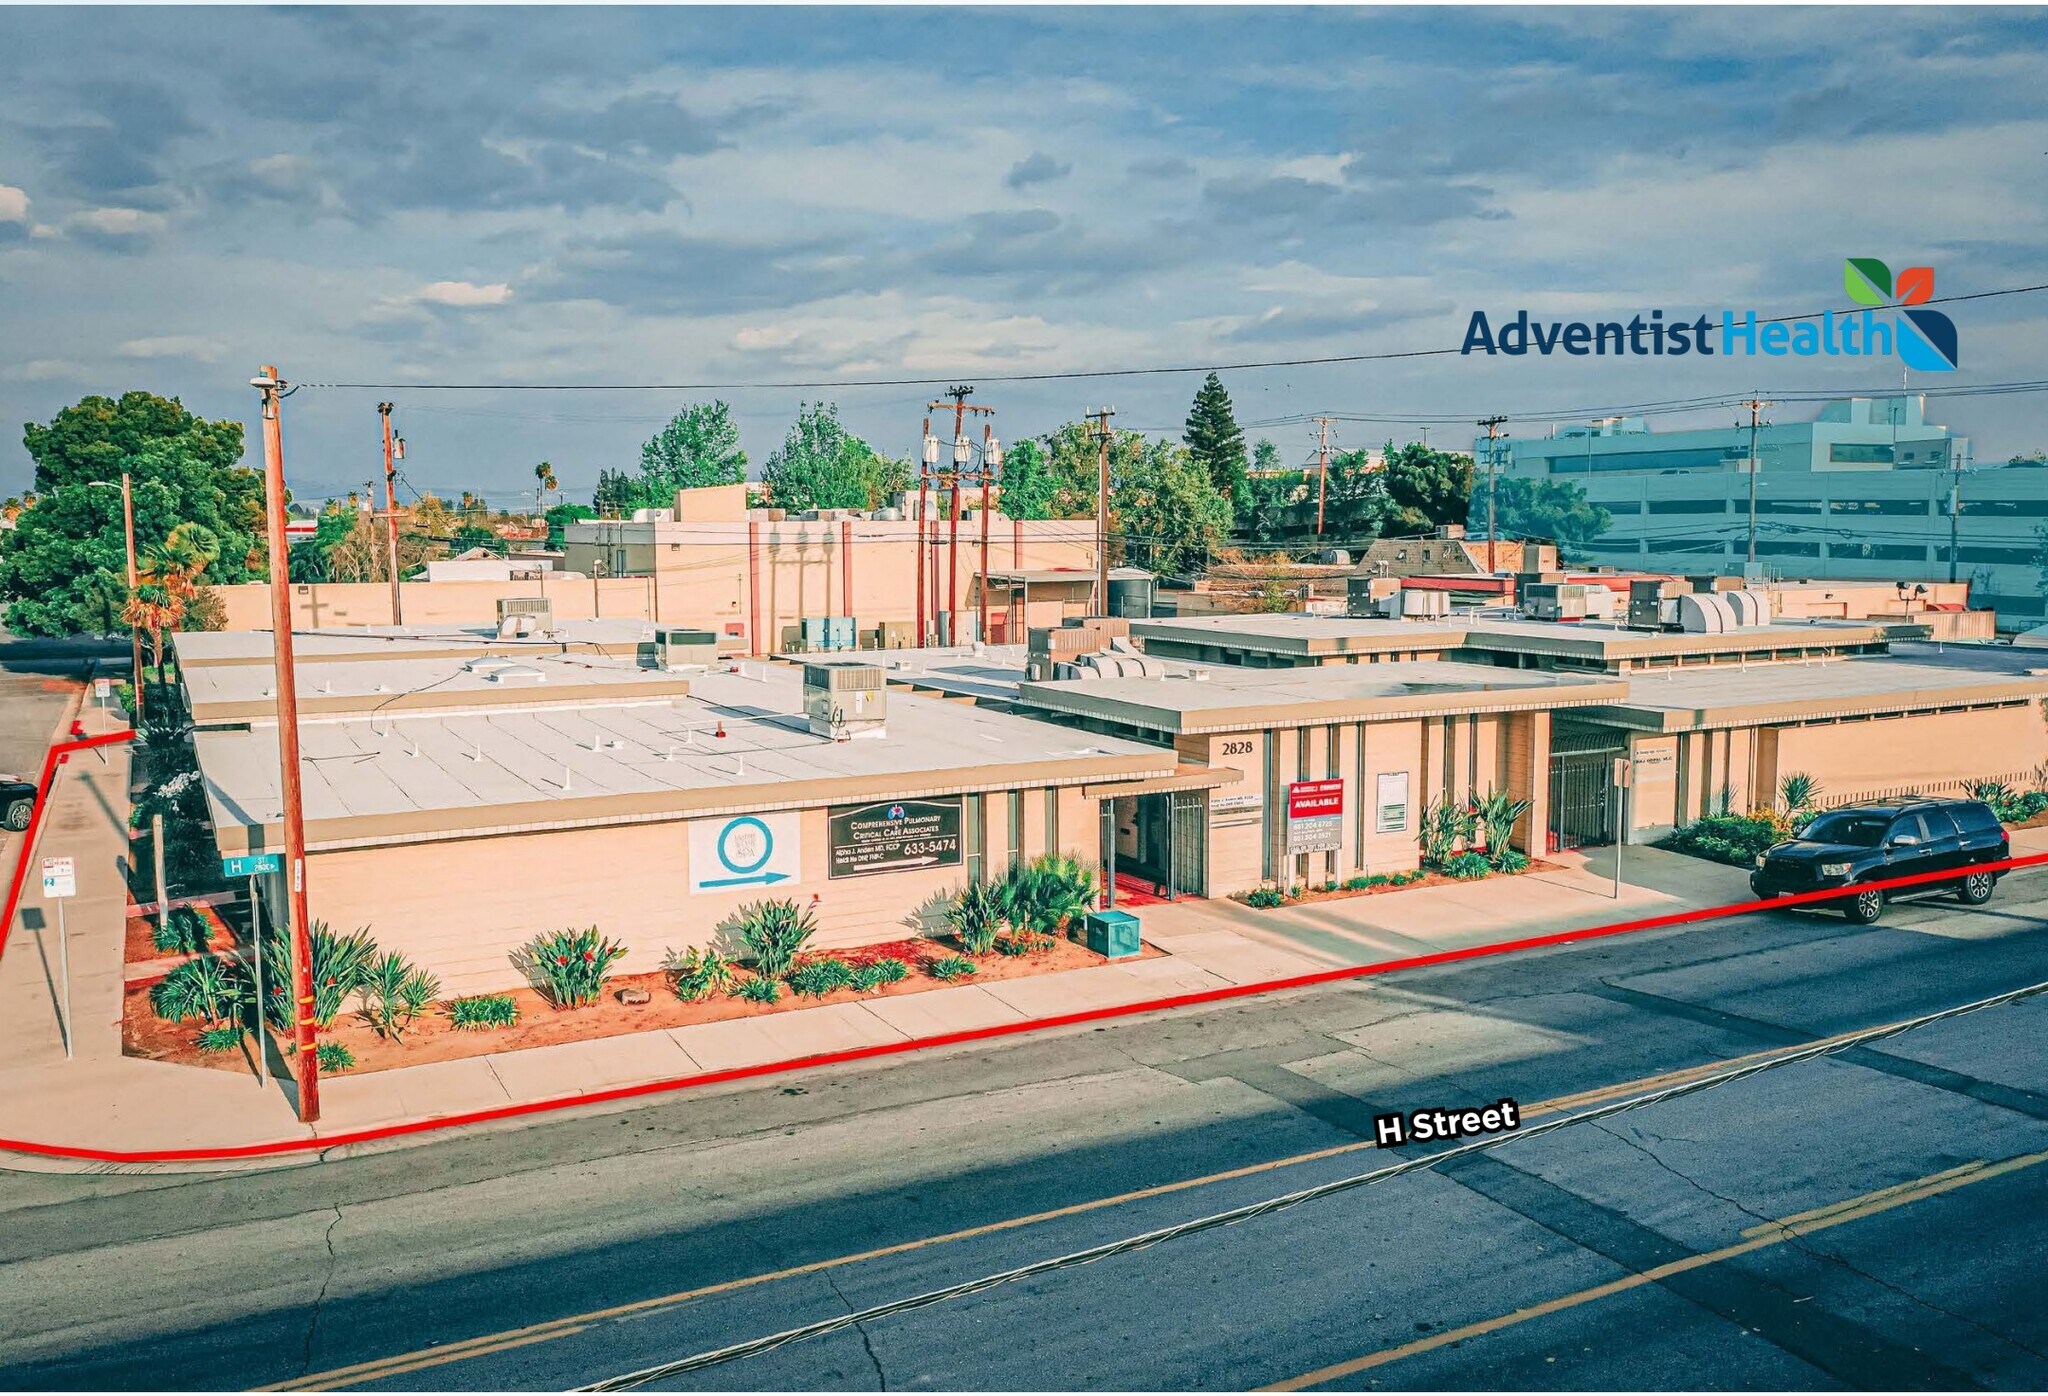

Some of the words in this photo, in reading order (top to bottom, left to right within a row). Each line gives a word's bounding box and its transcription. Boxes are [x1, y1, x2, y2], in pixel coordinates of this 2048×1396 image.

[1222, 741, 1253, 756] 2828
[1294, 797, 1339, 809] AVAILABLE
[904, 815, 941, 825] PULMONARY
[853, 831, 882, 840] CRITICAL
[883, 828, 902, 837] CARE
[902, 825, 939, 835] ASSOCIATES
[904, 839, 957, 856] 633-5474
[230, 859, 242, 874] H
